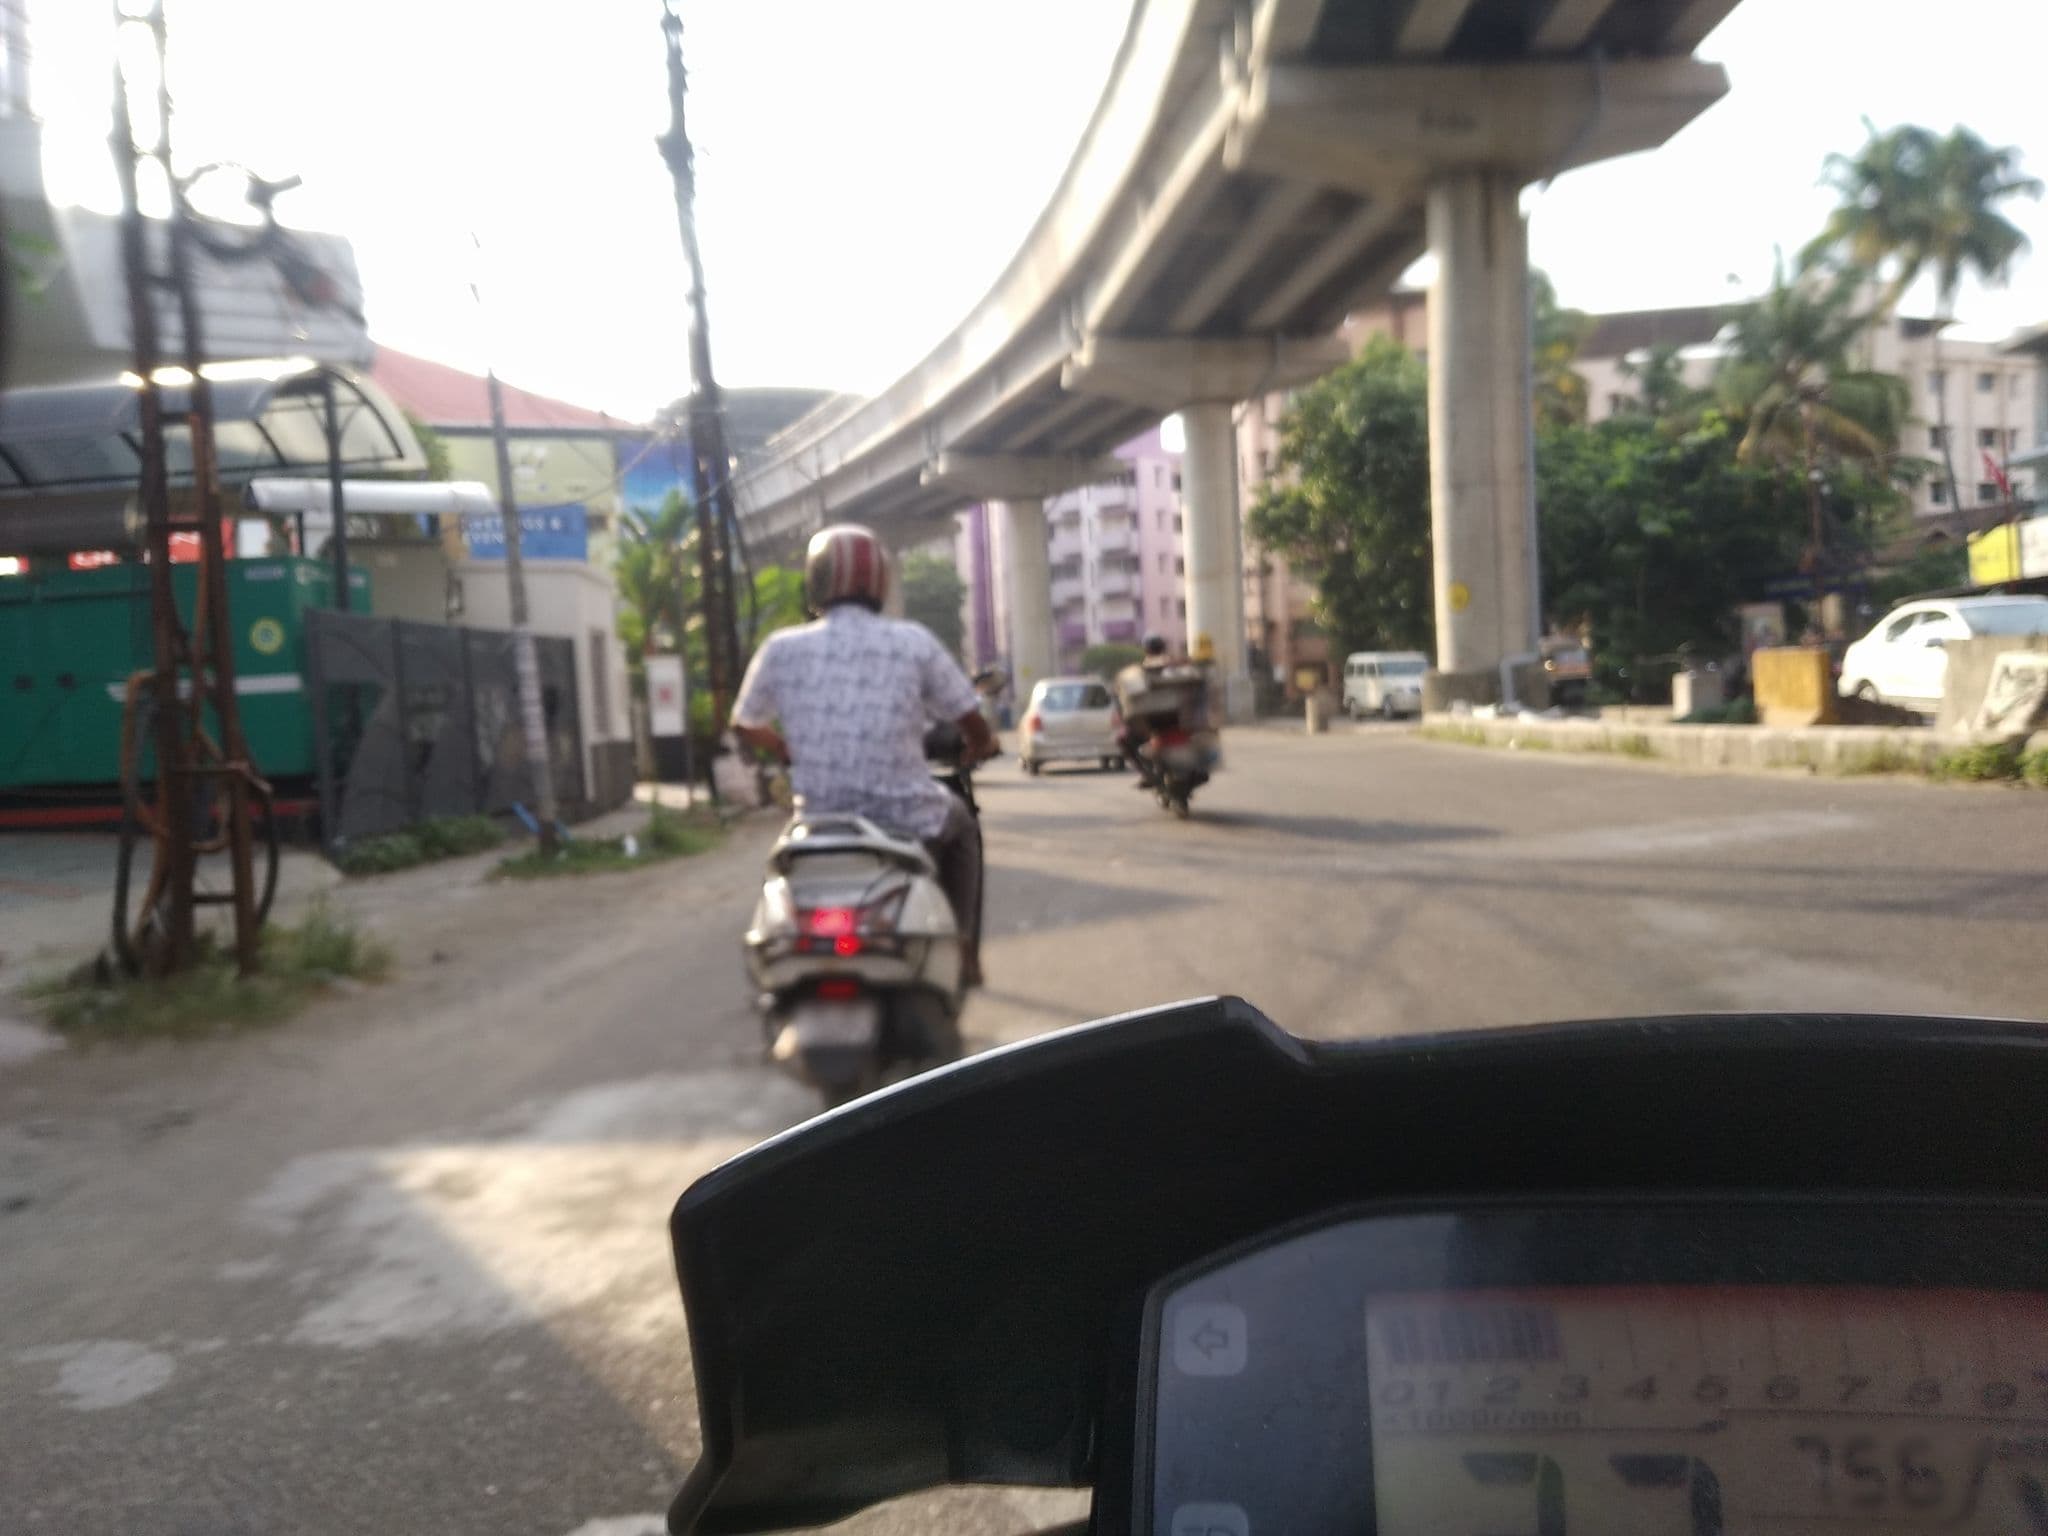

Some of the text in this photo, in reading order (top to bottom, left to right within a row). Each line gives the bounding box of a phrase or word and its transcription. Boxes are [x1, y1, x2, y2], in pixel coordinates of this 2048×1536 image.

[1482, 1375, 1522, 1404] 2
[1555, 1374, 1590, 1404] 3
[1622, 1374, 1658, 1403] 4
[1837, 1374, 1872, 1404] 7
